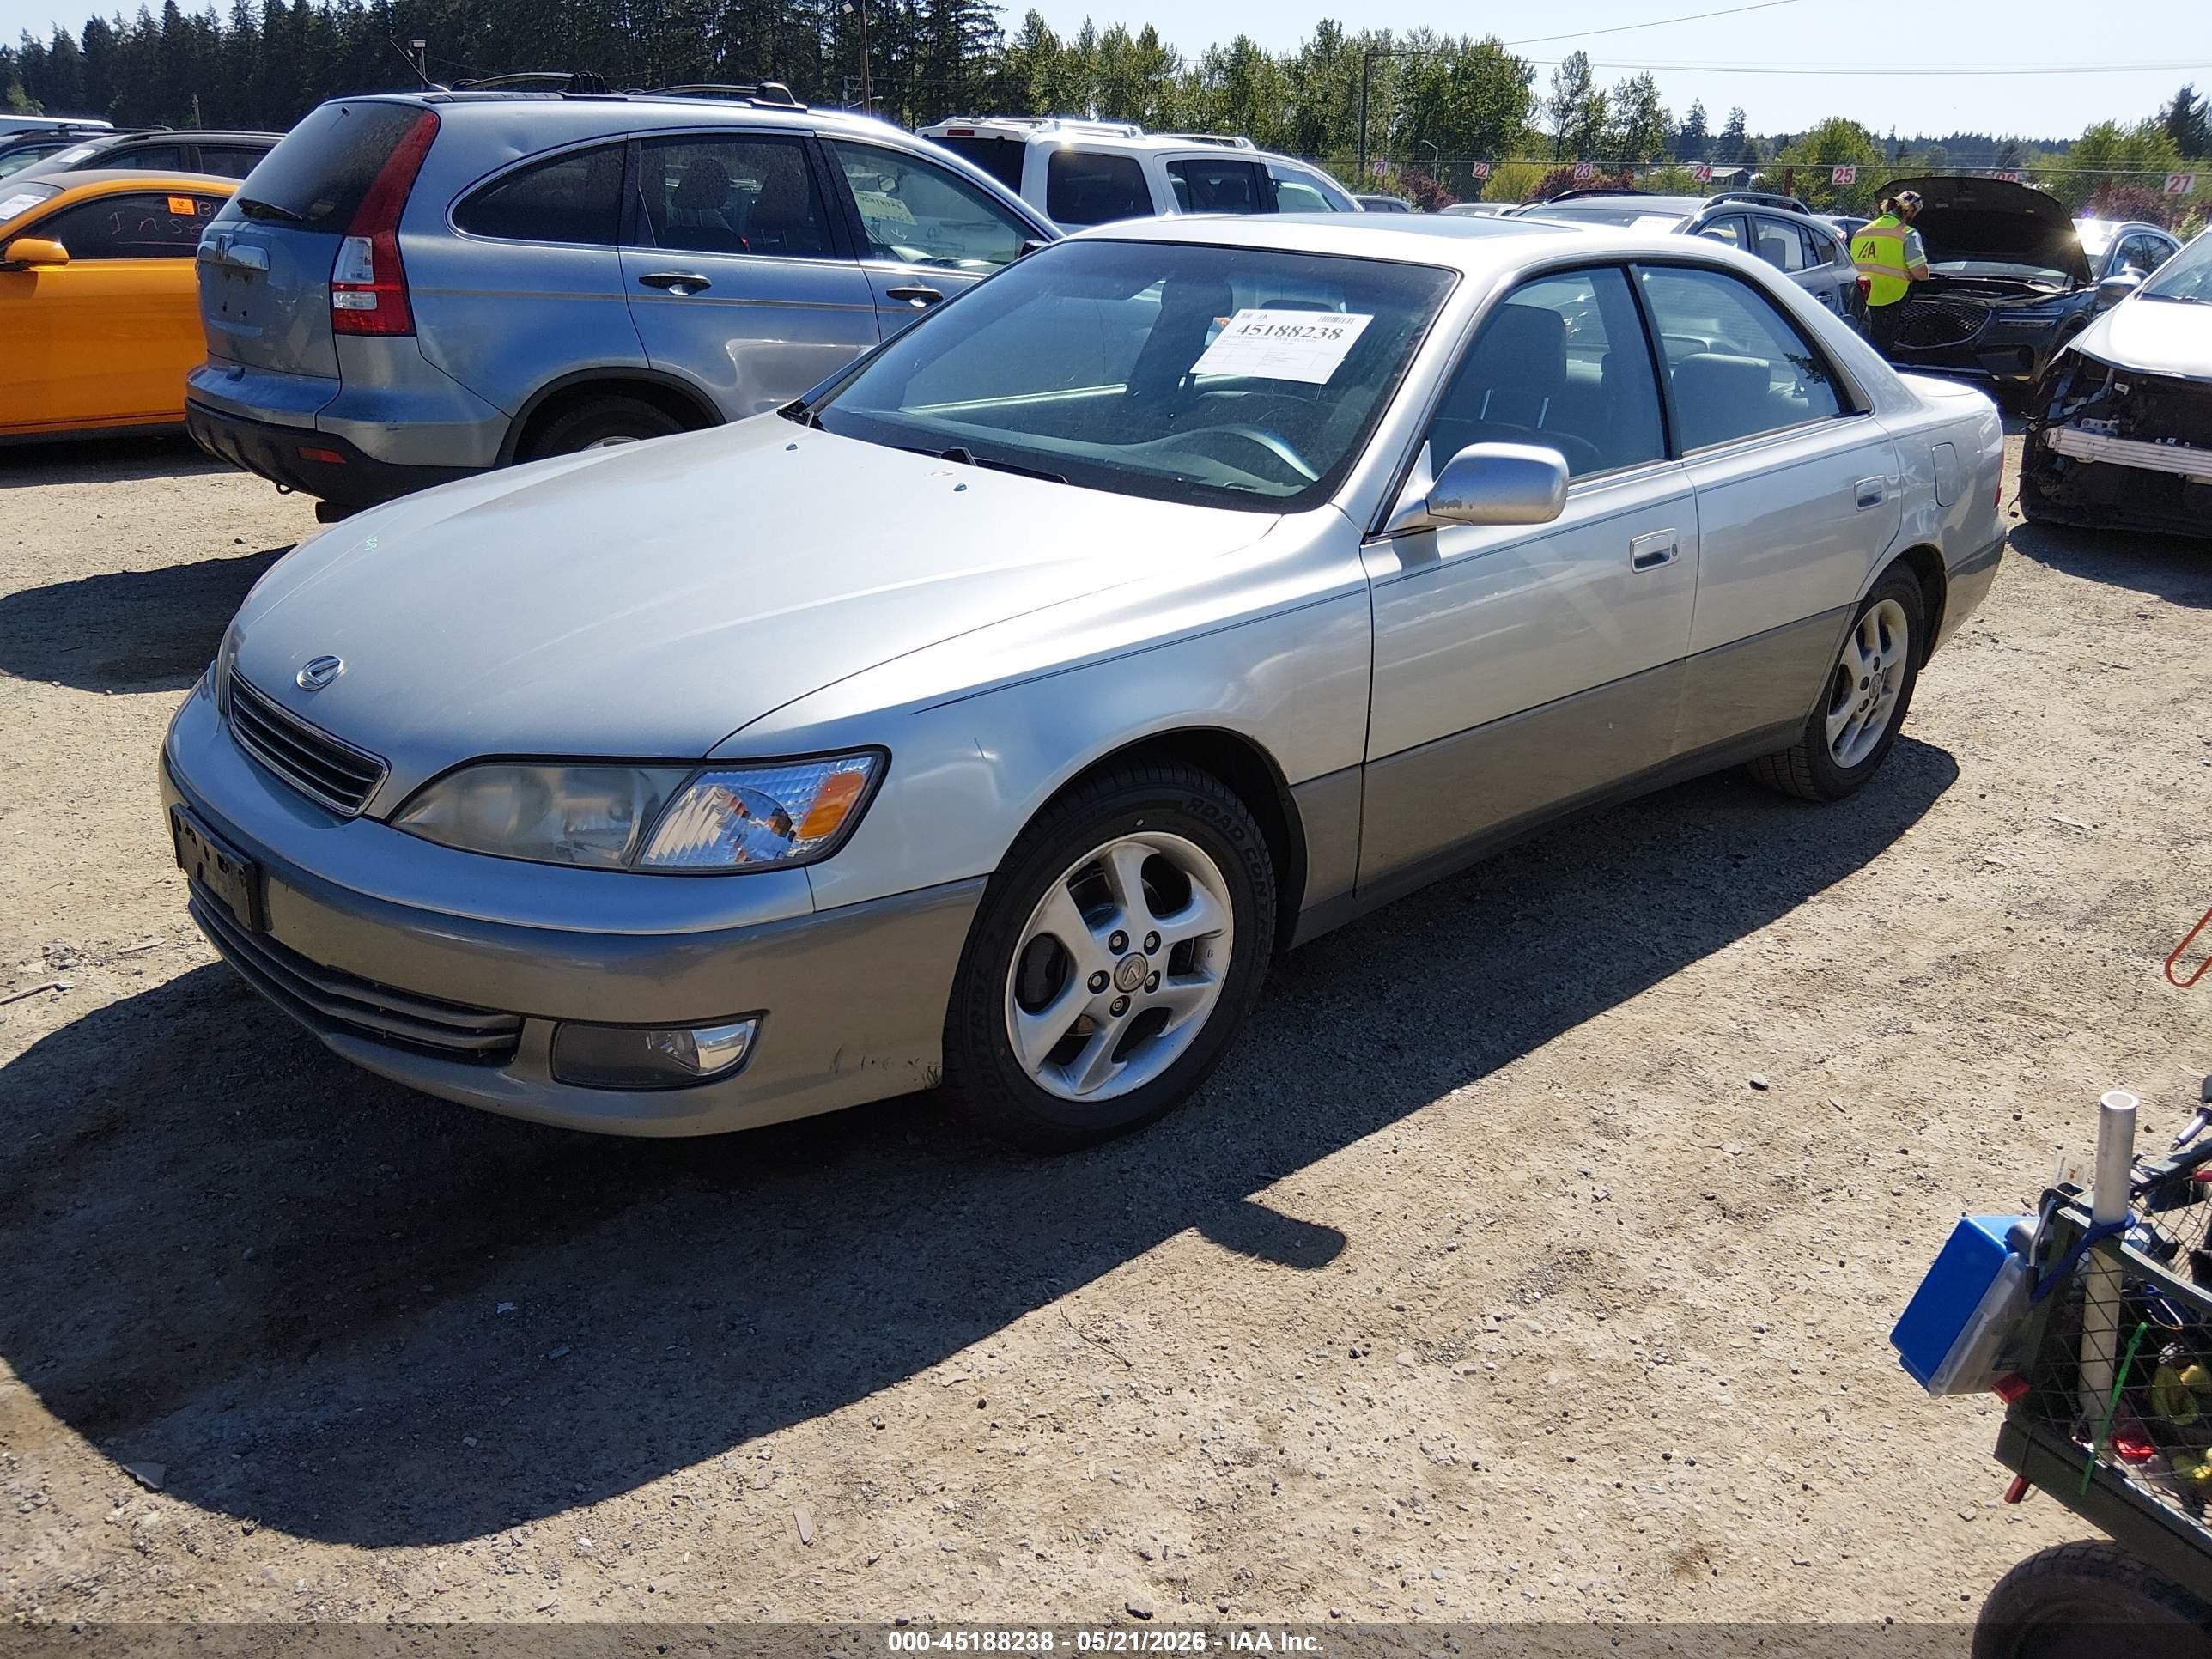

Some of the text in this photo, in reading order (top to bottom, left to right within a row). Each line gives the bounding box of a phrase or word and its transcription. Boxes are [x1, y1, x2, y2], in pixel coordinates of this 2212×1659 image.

[1375, 161, 1386, 175] 21
[1474, 163, 1489, 178] 22
[1576, 164, 1592, 179] 23
[1694, 165, 1711, 179] 24
[1833, 167, 1853, 184] 25
[2168, 175, 2191, 193] 27
[1236, 323, 1344, 341] 45188238
[1187, 797, 1269, 967] ROAD CONTRO
